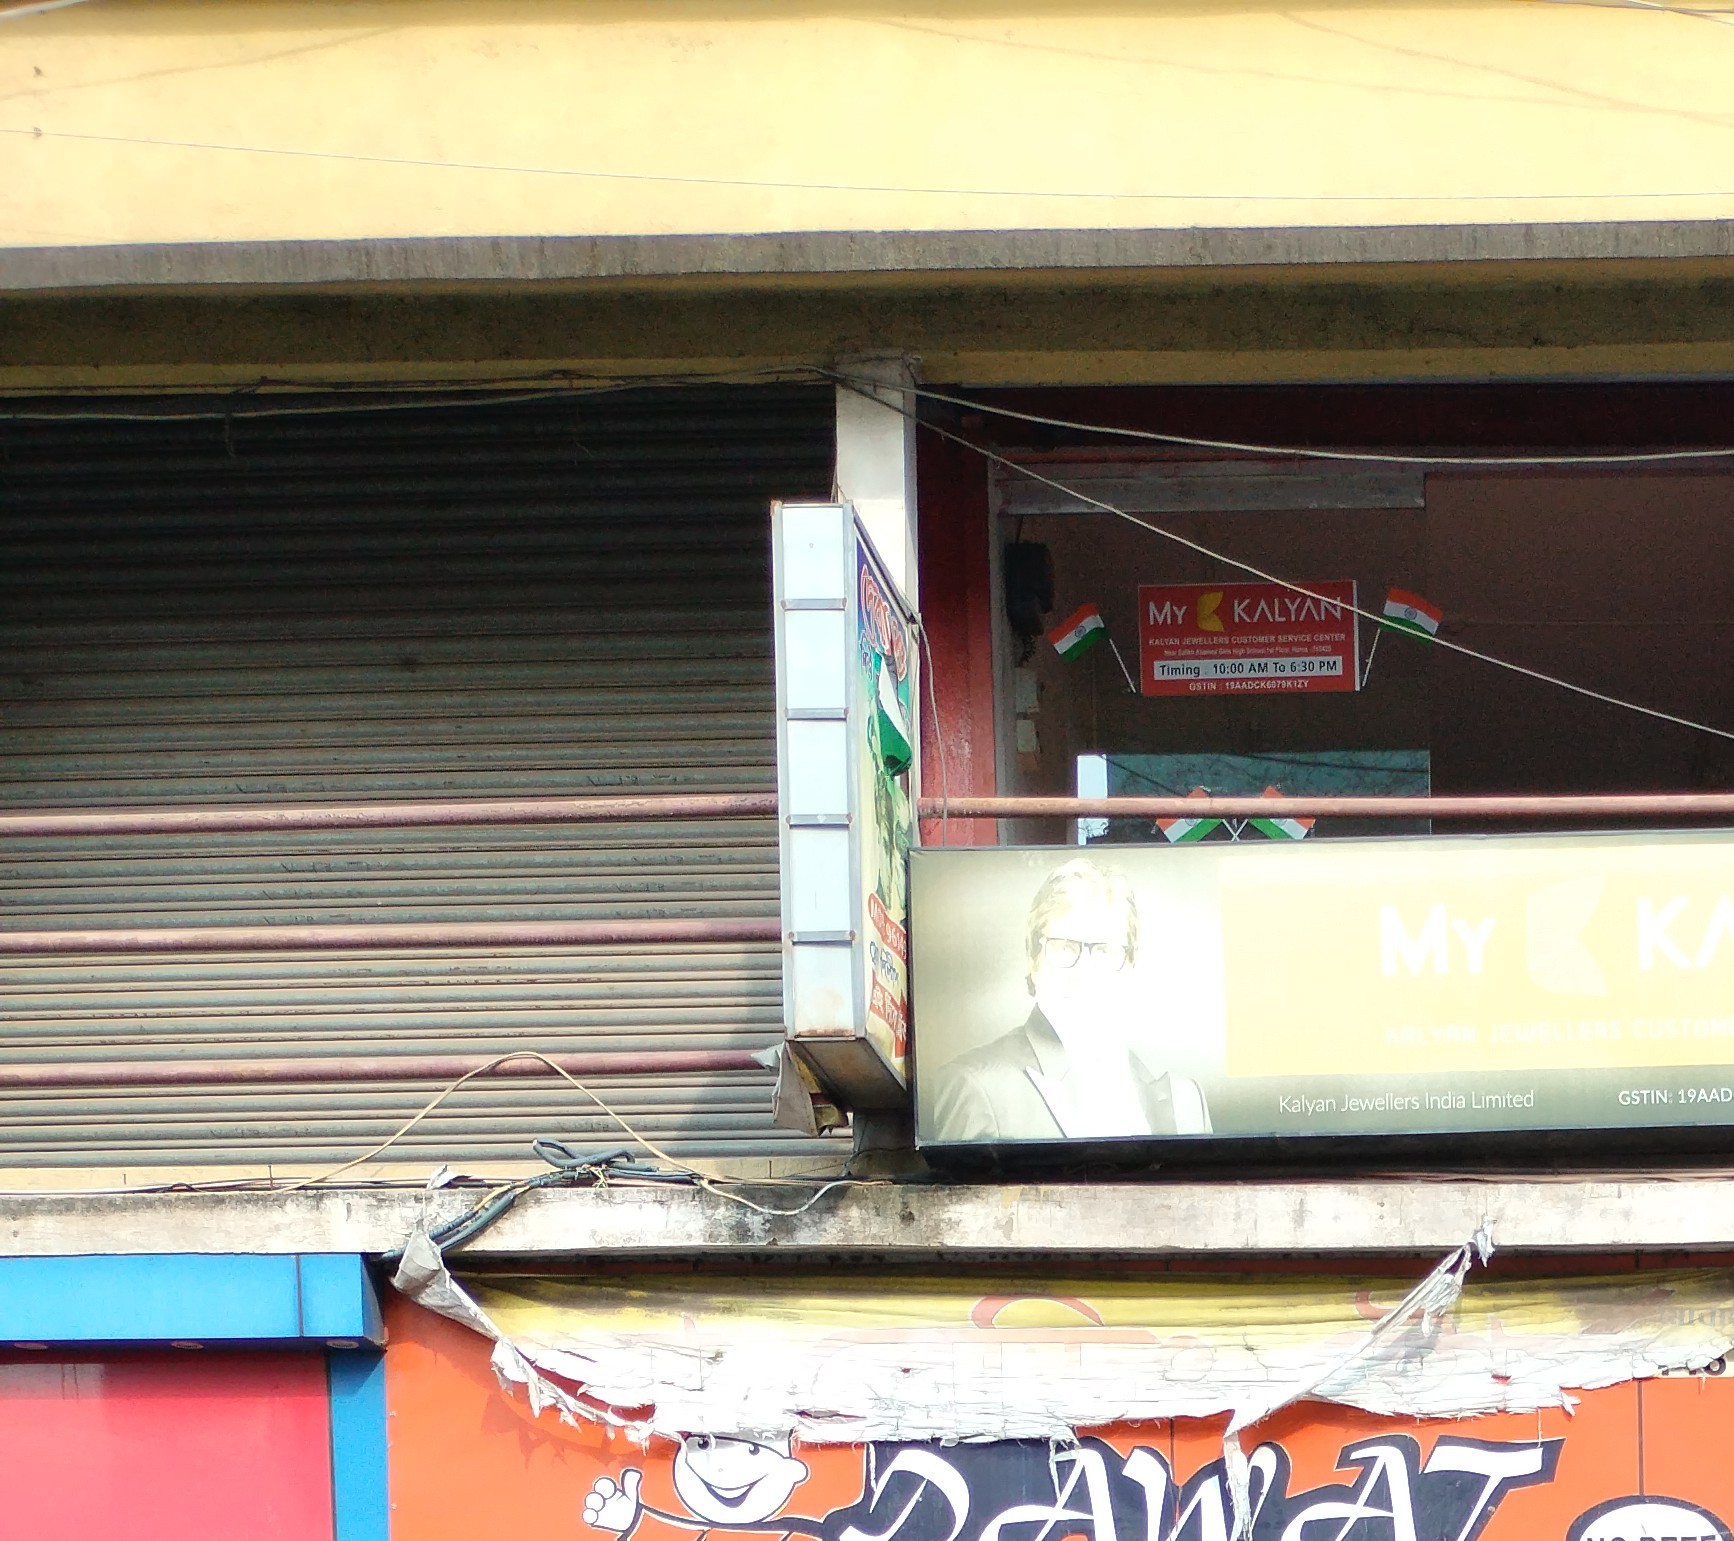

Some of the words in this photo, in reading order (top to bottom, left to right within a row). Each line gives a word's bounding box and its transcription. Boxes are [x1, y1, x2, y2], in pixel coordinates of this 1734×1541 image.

[1233, 596, 1342, 624] KALYAN
[1149, 637, 1180, 646] KALYAN
[1182, 636, 1229, 645] JEWELLERS
[1231, 634, 1276, 644] CUSTOMER
[1278, 633, 1312, 643] SERVICE
[1314, 632, 1346, 642] CENTER
[1160, 663, 1200, 678] Timing
[1213, 663, 1244, 675] 10:00
[1248, 662, 1268, 673] AM
[1273, 662, 1286, 673] To
[1319, 660, 1337, 671] PM
[1279, 1094, 1336, 1117] Kalyan
[1341, 1093, 1420, 1112] Jewellers
[1425, 1091, 1466, 1110] India
[1471, 1089, 1535, 1110] Limited
[1618, 1089, 1673, 1107] GSTIN:
